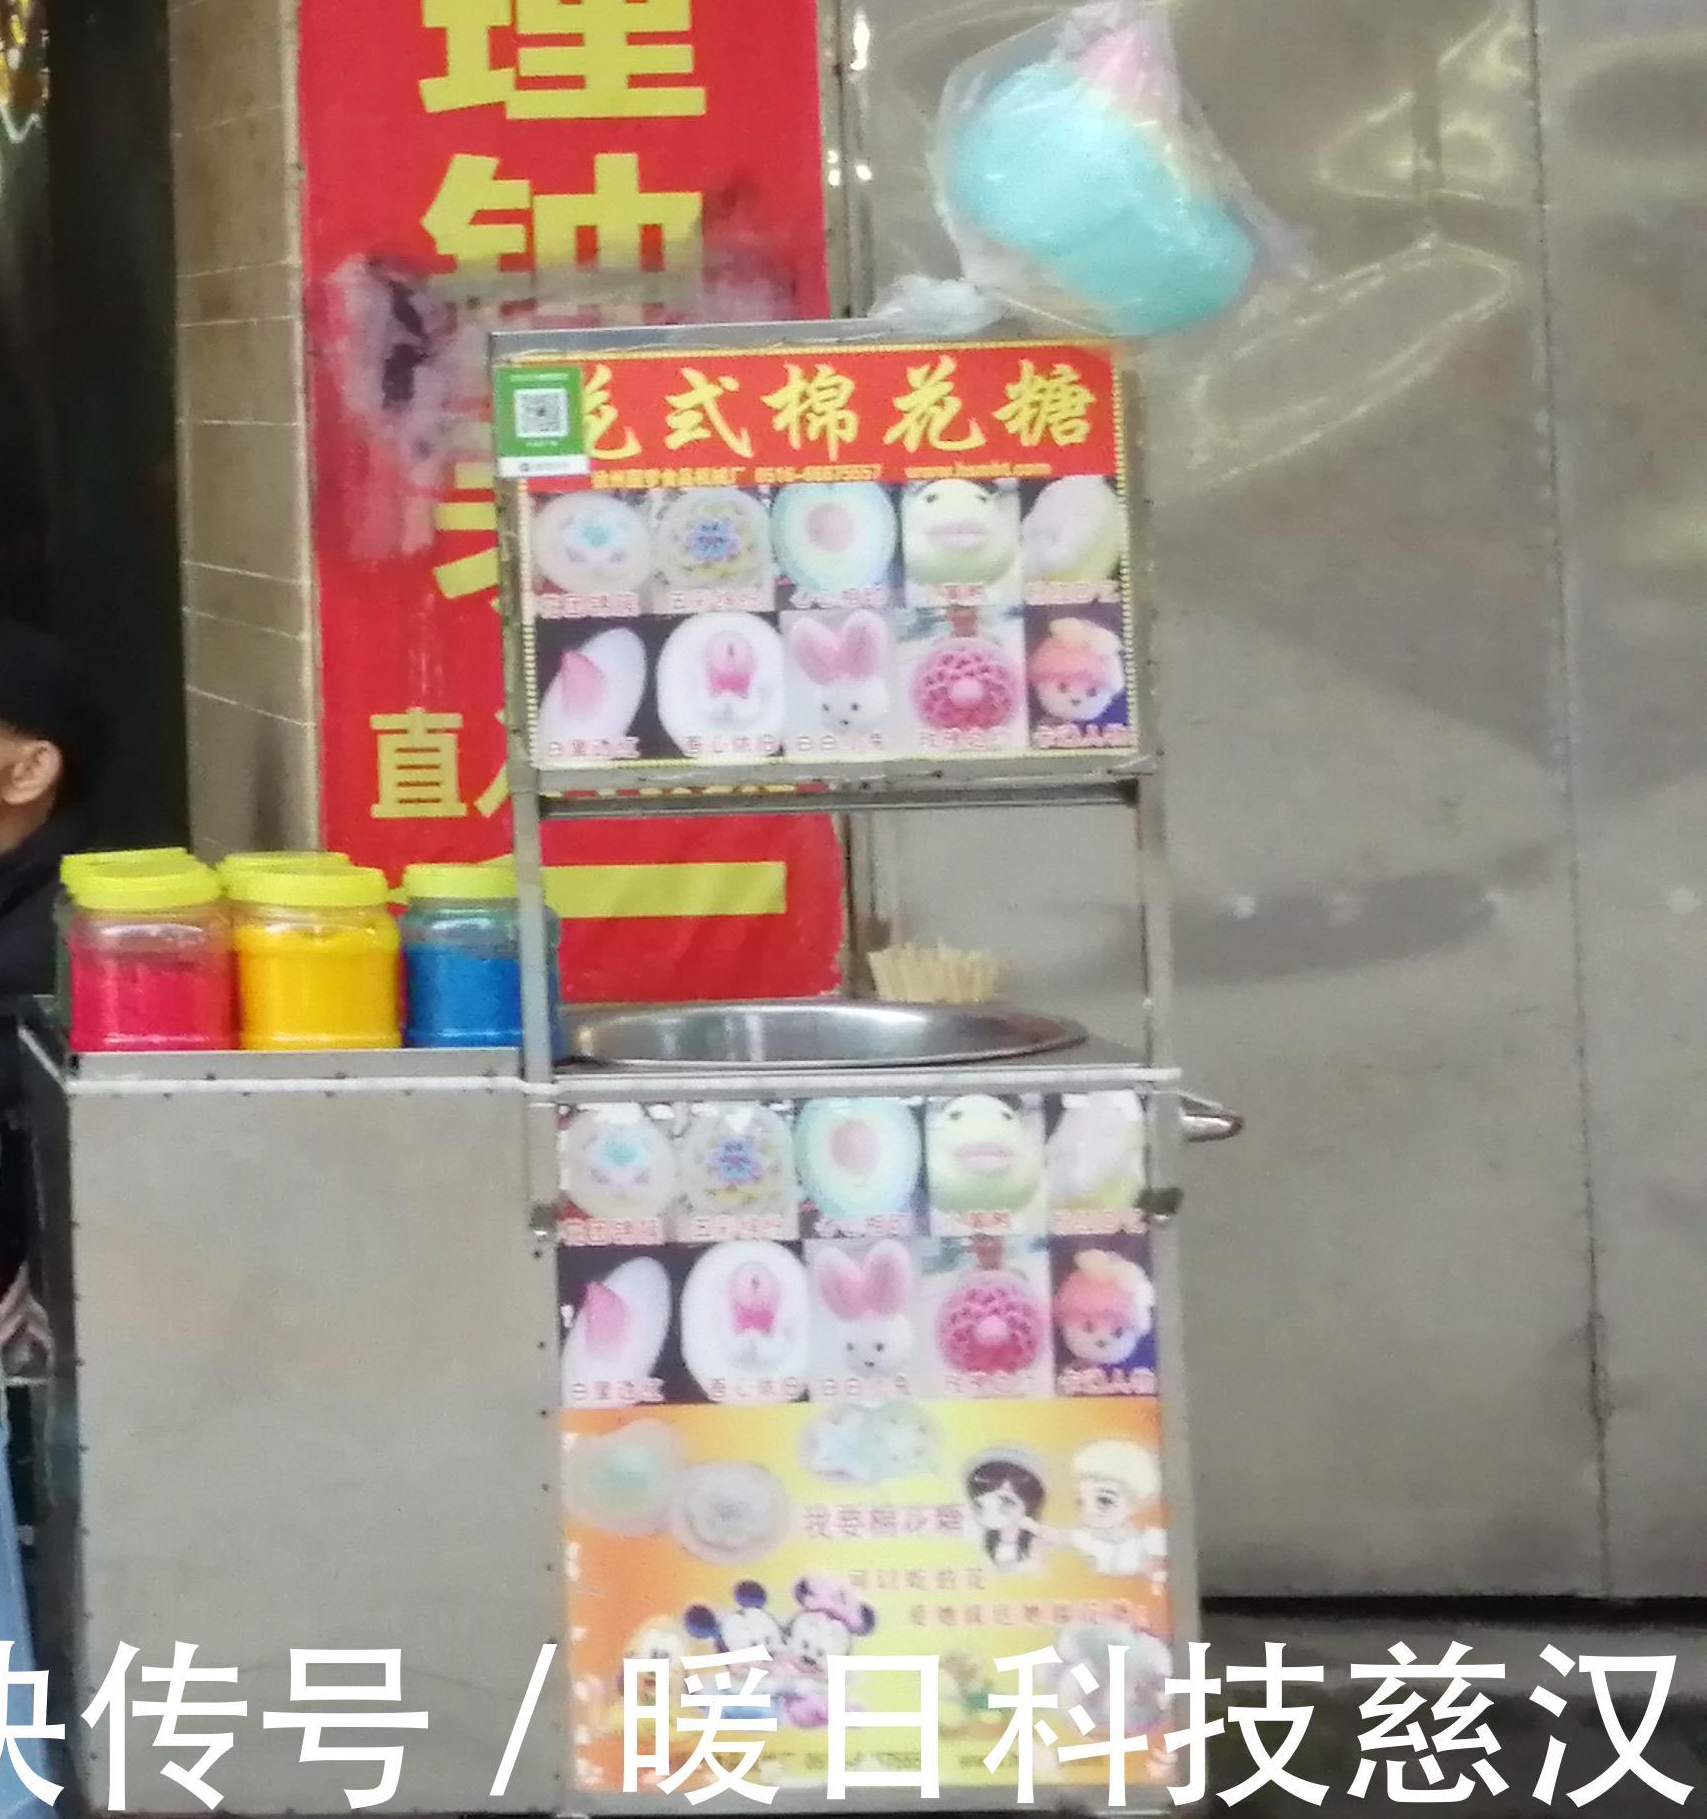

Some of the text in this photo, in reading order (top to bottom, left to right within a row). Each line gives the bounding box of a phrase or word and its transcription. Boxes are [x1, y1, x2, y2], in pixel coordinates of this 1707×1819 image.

[583, 354, 1097, 462] 花式棉花糖
